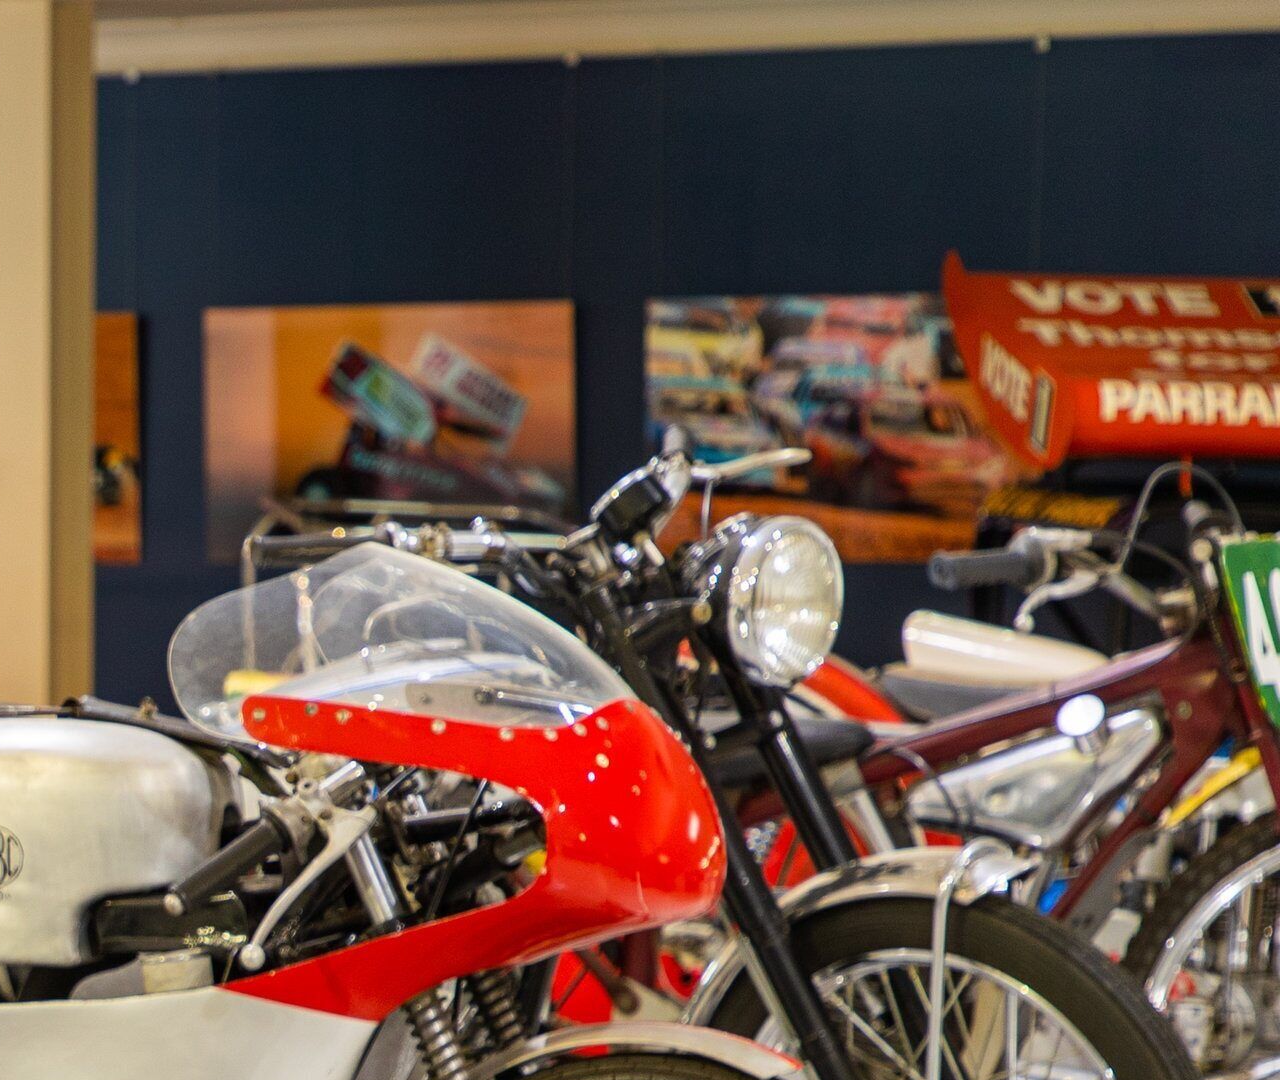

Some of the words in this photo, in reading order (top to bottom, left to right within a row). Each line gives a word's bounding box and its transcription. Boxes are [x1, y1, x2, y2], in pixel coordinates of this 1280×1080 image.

[1010, 279, 1221, 318] VOTE
[1016, 316, 1280, 348] Thoms
[980, 332, 1032, 423] VOTE
[1098, 378, 1280, 427] PARRA
